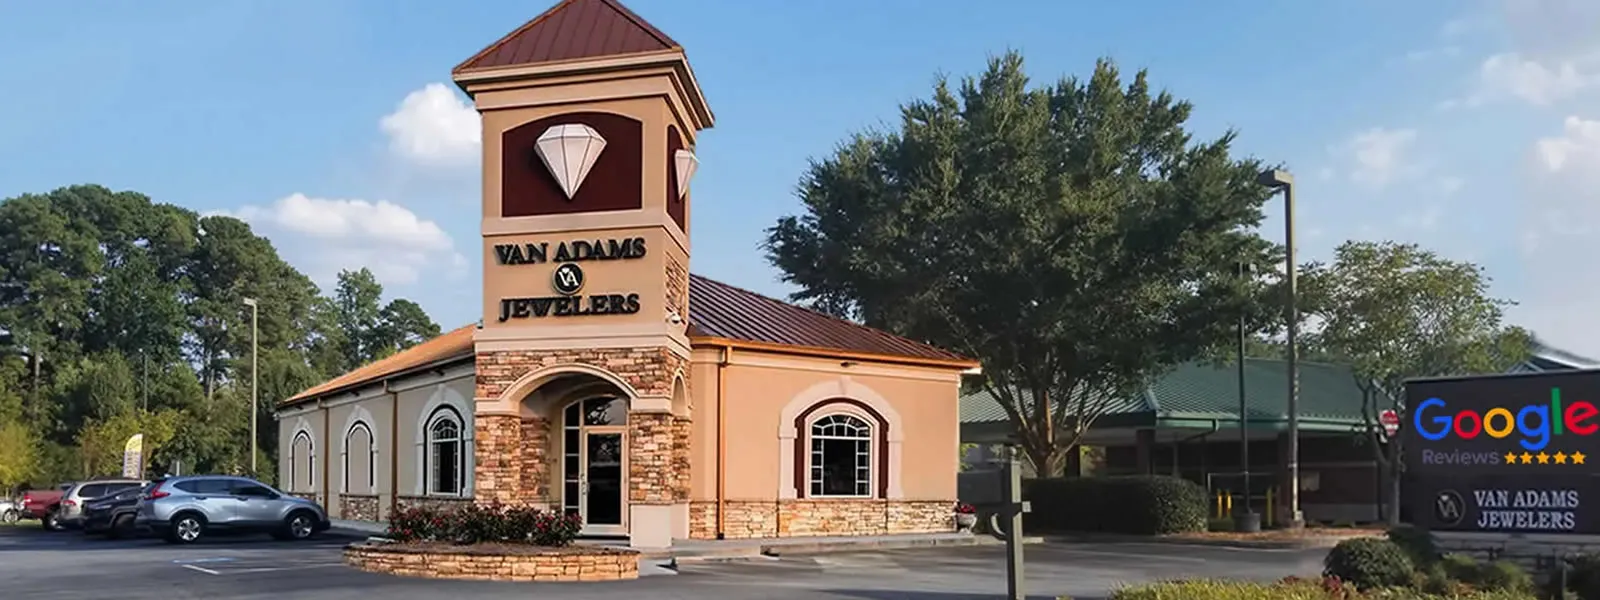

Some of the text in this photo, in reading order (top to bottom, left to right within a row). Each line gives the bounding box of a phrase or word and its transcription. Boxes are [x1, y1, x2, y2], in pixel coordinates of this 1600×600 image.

[495, 237, 646, 265] VAN ADAMS
[499, 293, 641, 322] JEWELERS
[1413, 387, 1600, 451] Google
[1422, 450, 1500, 465] Reviews
[1473, 490, 1579, 508] VAN ADAMS
[1477, 510, 1575, 529] JEWELERS
